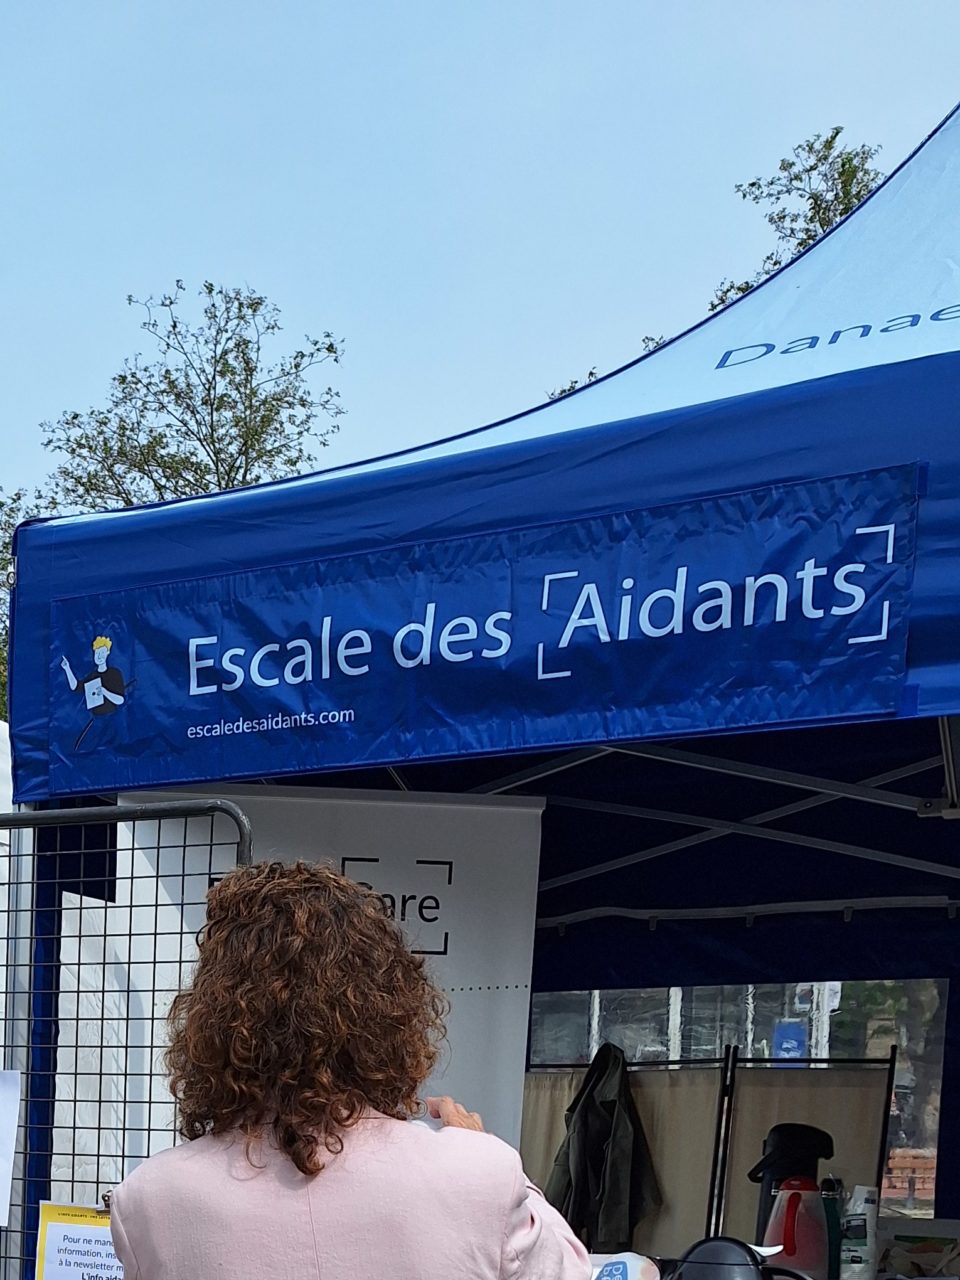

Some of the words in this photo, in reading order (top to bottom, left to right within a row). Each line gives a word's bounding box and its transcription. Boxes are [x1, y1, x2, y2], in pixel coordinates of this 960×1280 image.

[187, 616, 372, 696] Escale
[393, 602, 512, 668] des
[558, 558, 867, 648] Aidants
[186, 706, 355, 739] escaledesaidants.com
[63, 1234, 81, 1244] Pour
[57, 1248, 104, 1259] information,
[65, 1259, 72, 1267] la
[73, 1260, 114, 1271] newsletter
